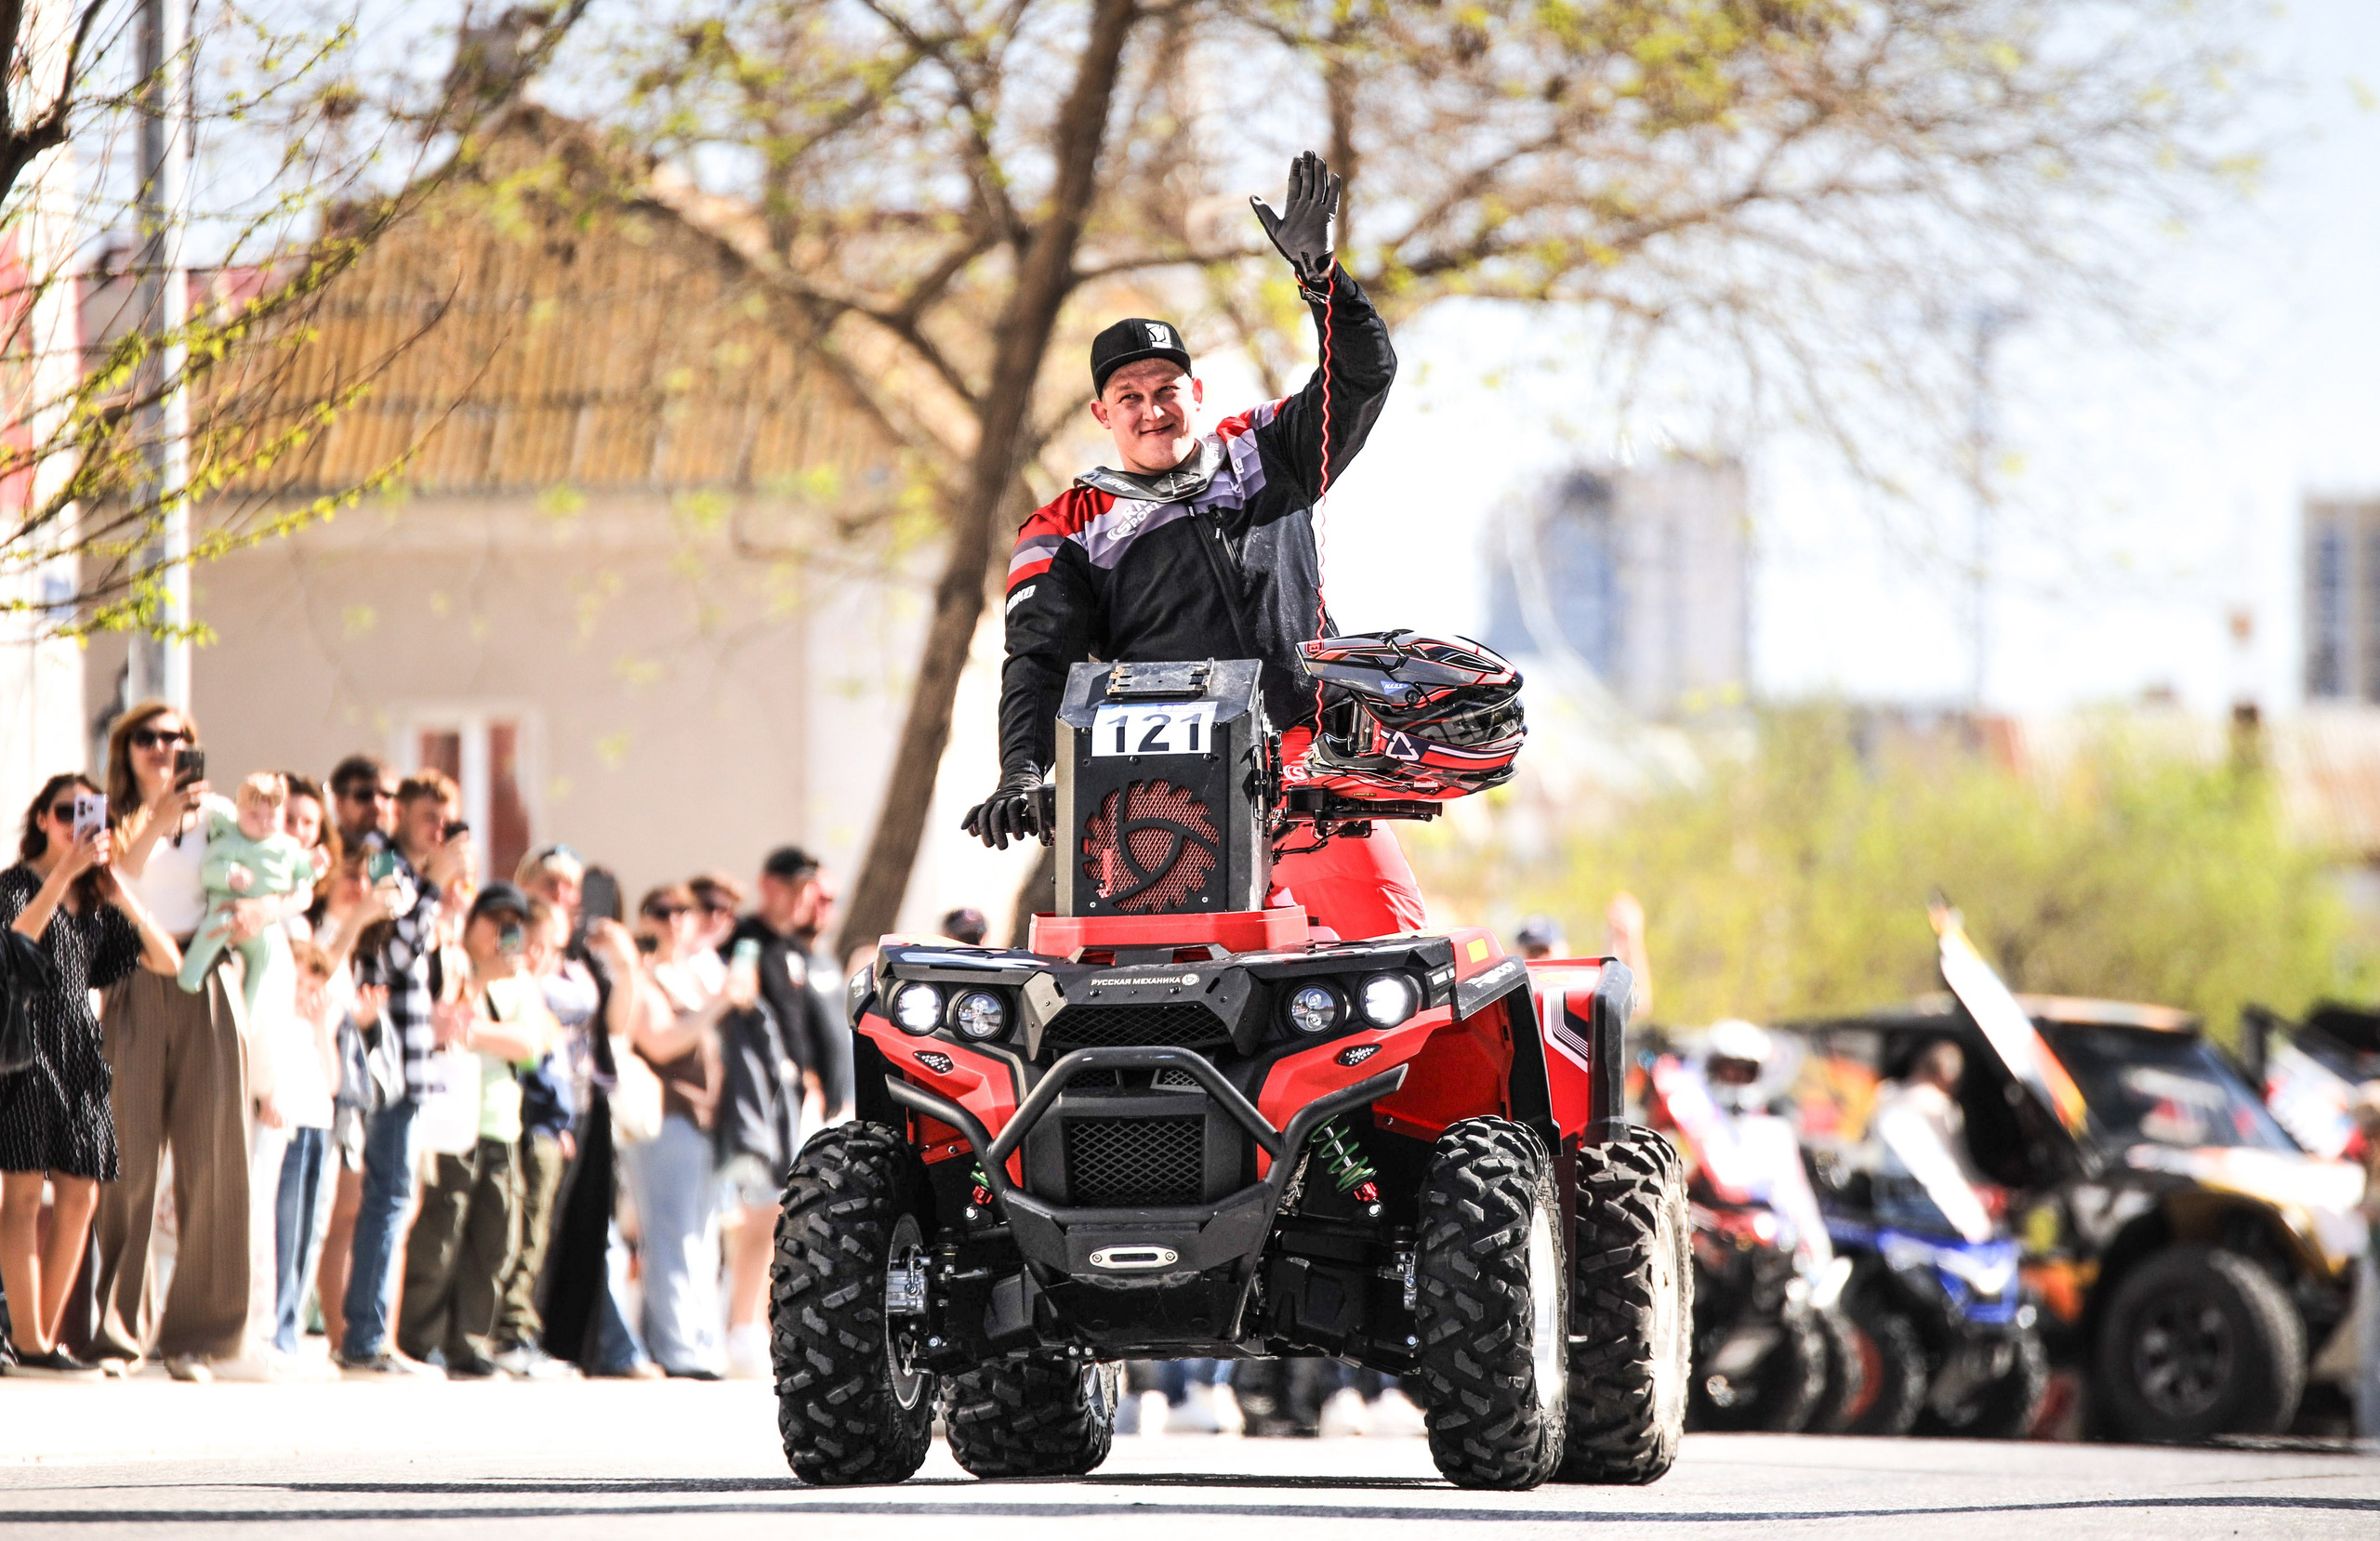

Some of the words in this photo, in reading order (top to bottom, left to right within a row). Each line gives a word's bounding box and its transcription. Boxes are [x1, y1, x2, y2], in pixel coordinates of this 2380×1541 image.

[1101, 477, 1136, 492] LEATT
[1117, 502, 1160, 533] SPORT
[1106, 713, 1202, 753] 121
[1091, 978, 1131, 986] РУССКАЯ
[1132, 977, 1181, 985] МЕХАНИКА
